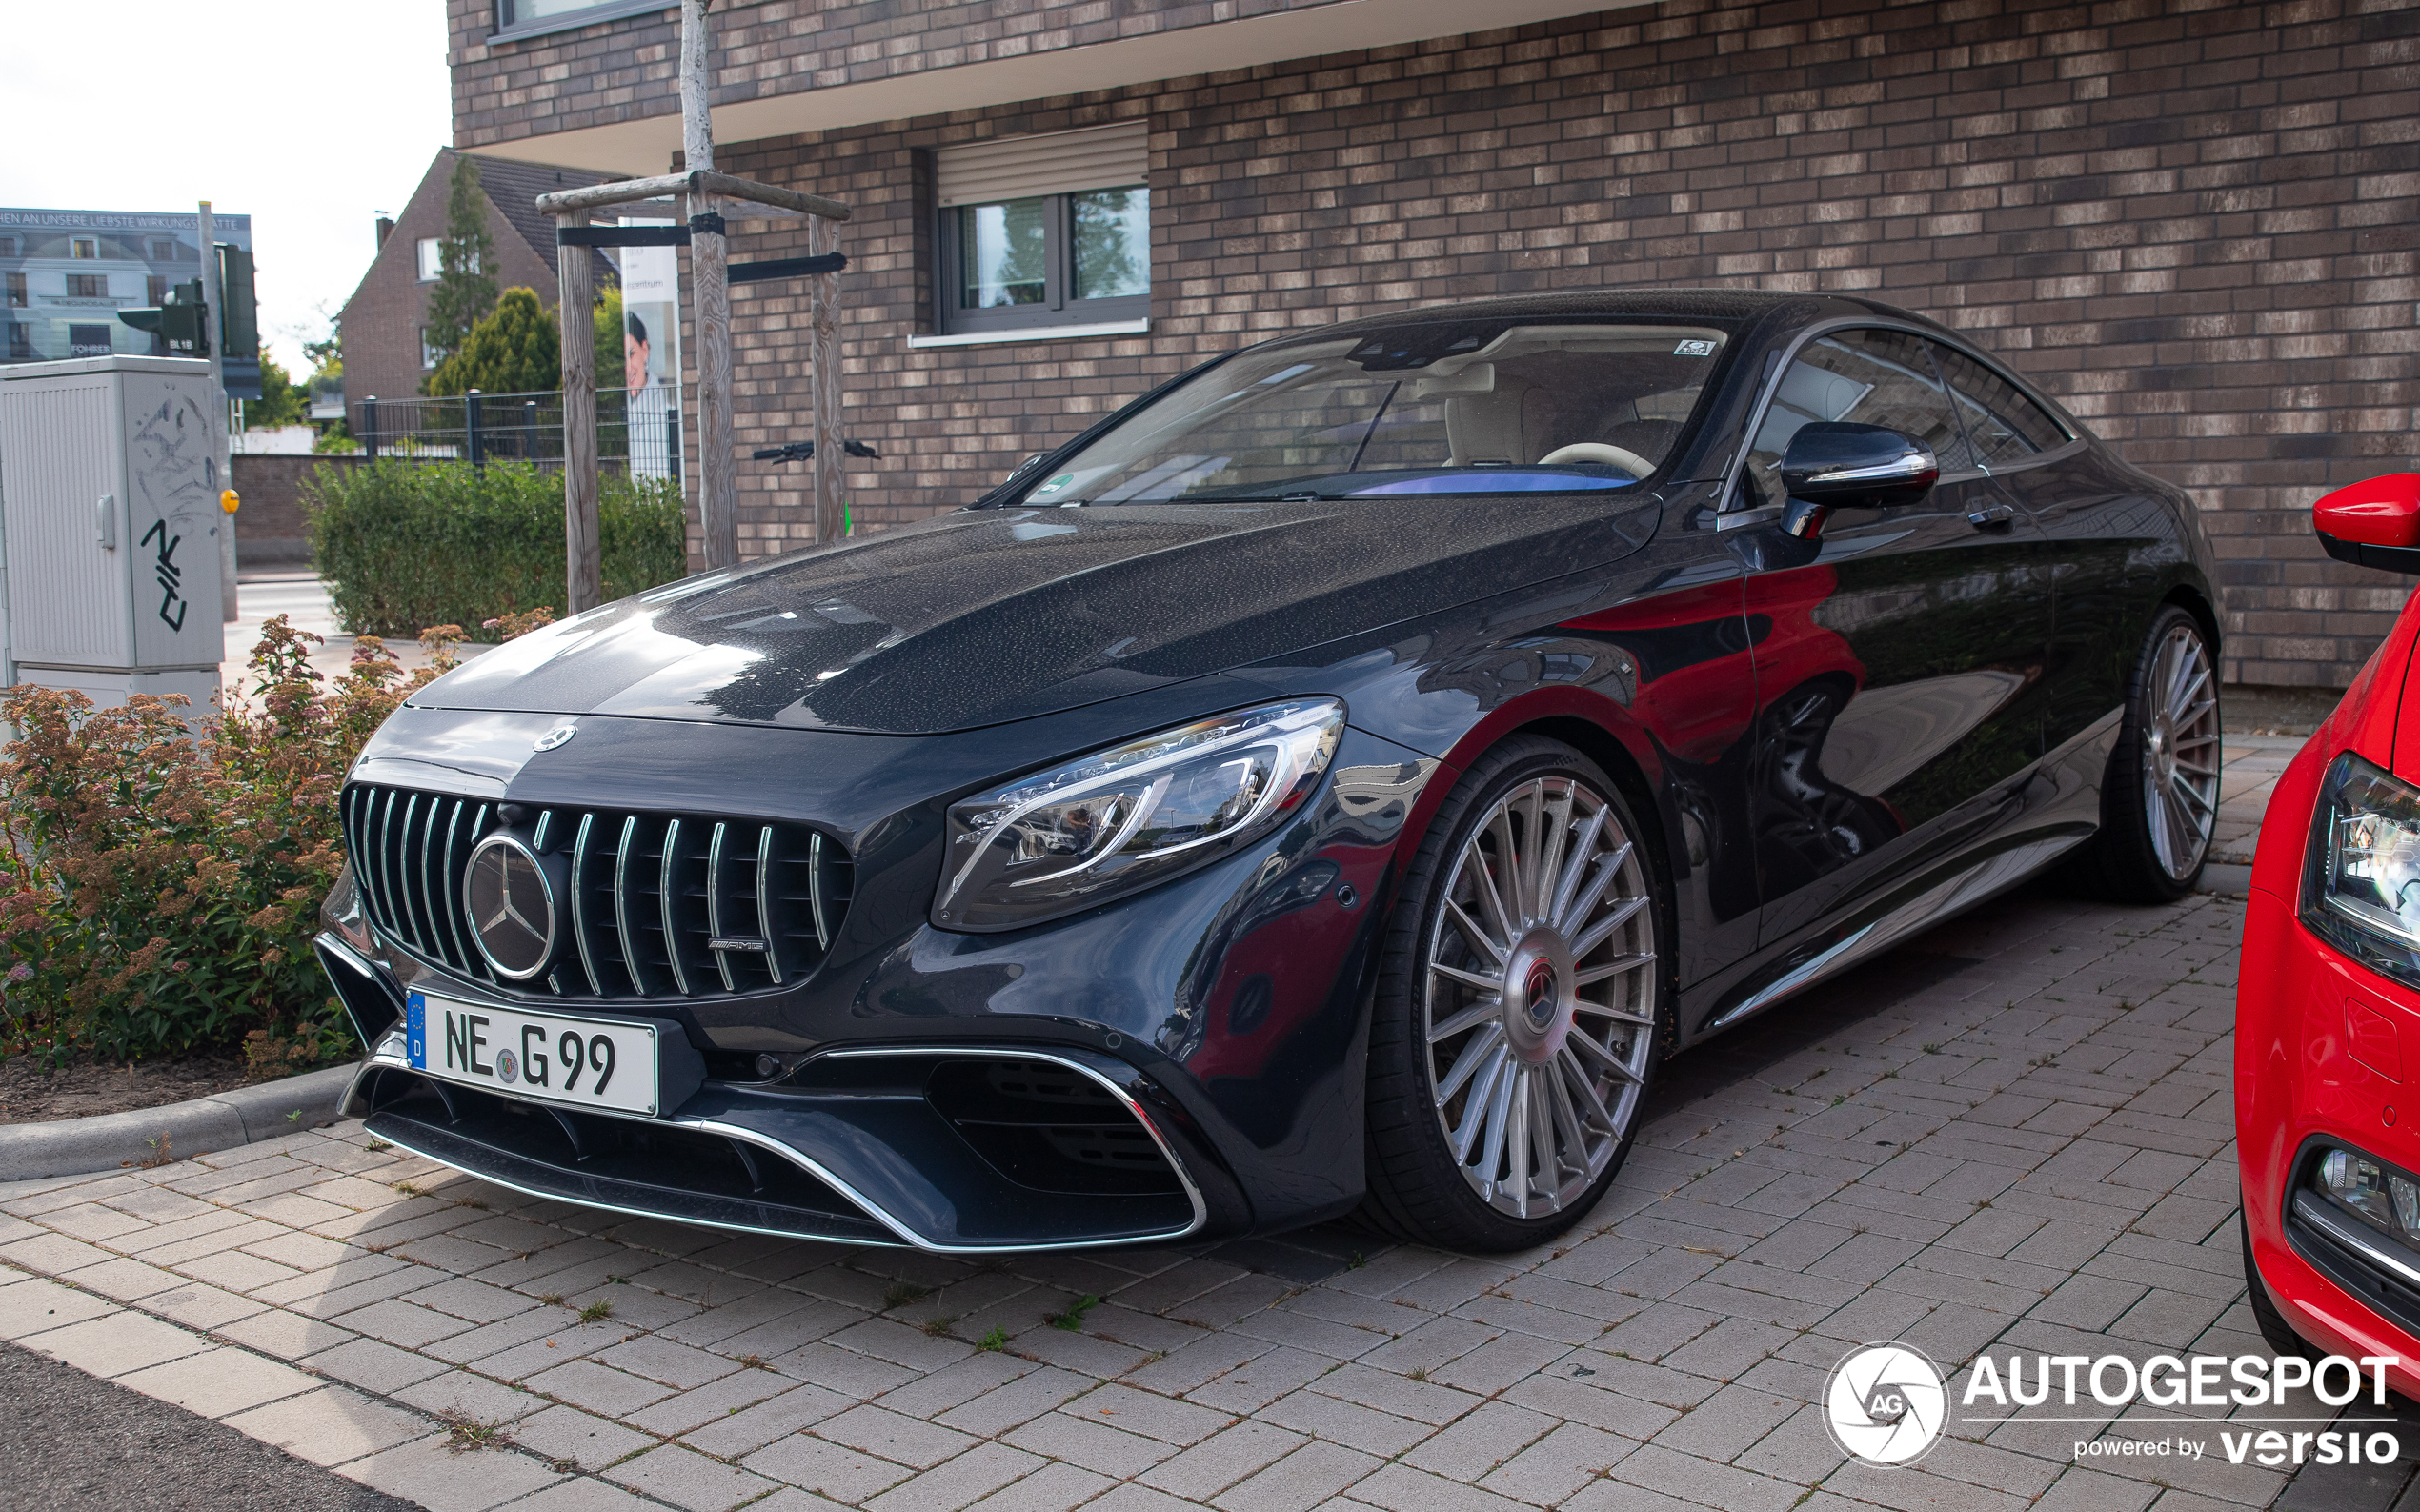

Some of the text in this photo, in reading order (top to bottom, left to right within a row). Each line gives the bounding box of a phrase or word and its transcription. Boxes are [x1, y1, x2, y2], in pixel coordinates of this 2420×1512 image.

[22, 213, 40, 224] AN
[41, 214, 88, 227] UNSERE
[90, 215, 135, 228] LIEBSTE
[726, 941, 763, 950] AMG
[413, 1039, 421, 1057] D
[446, 1010, 493, 1077] NE
